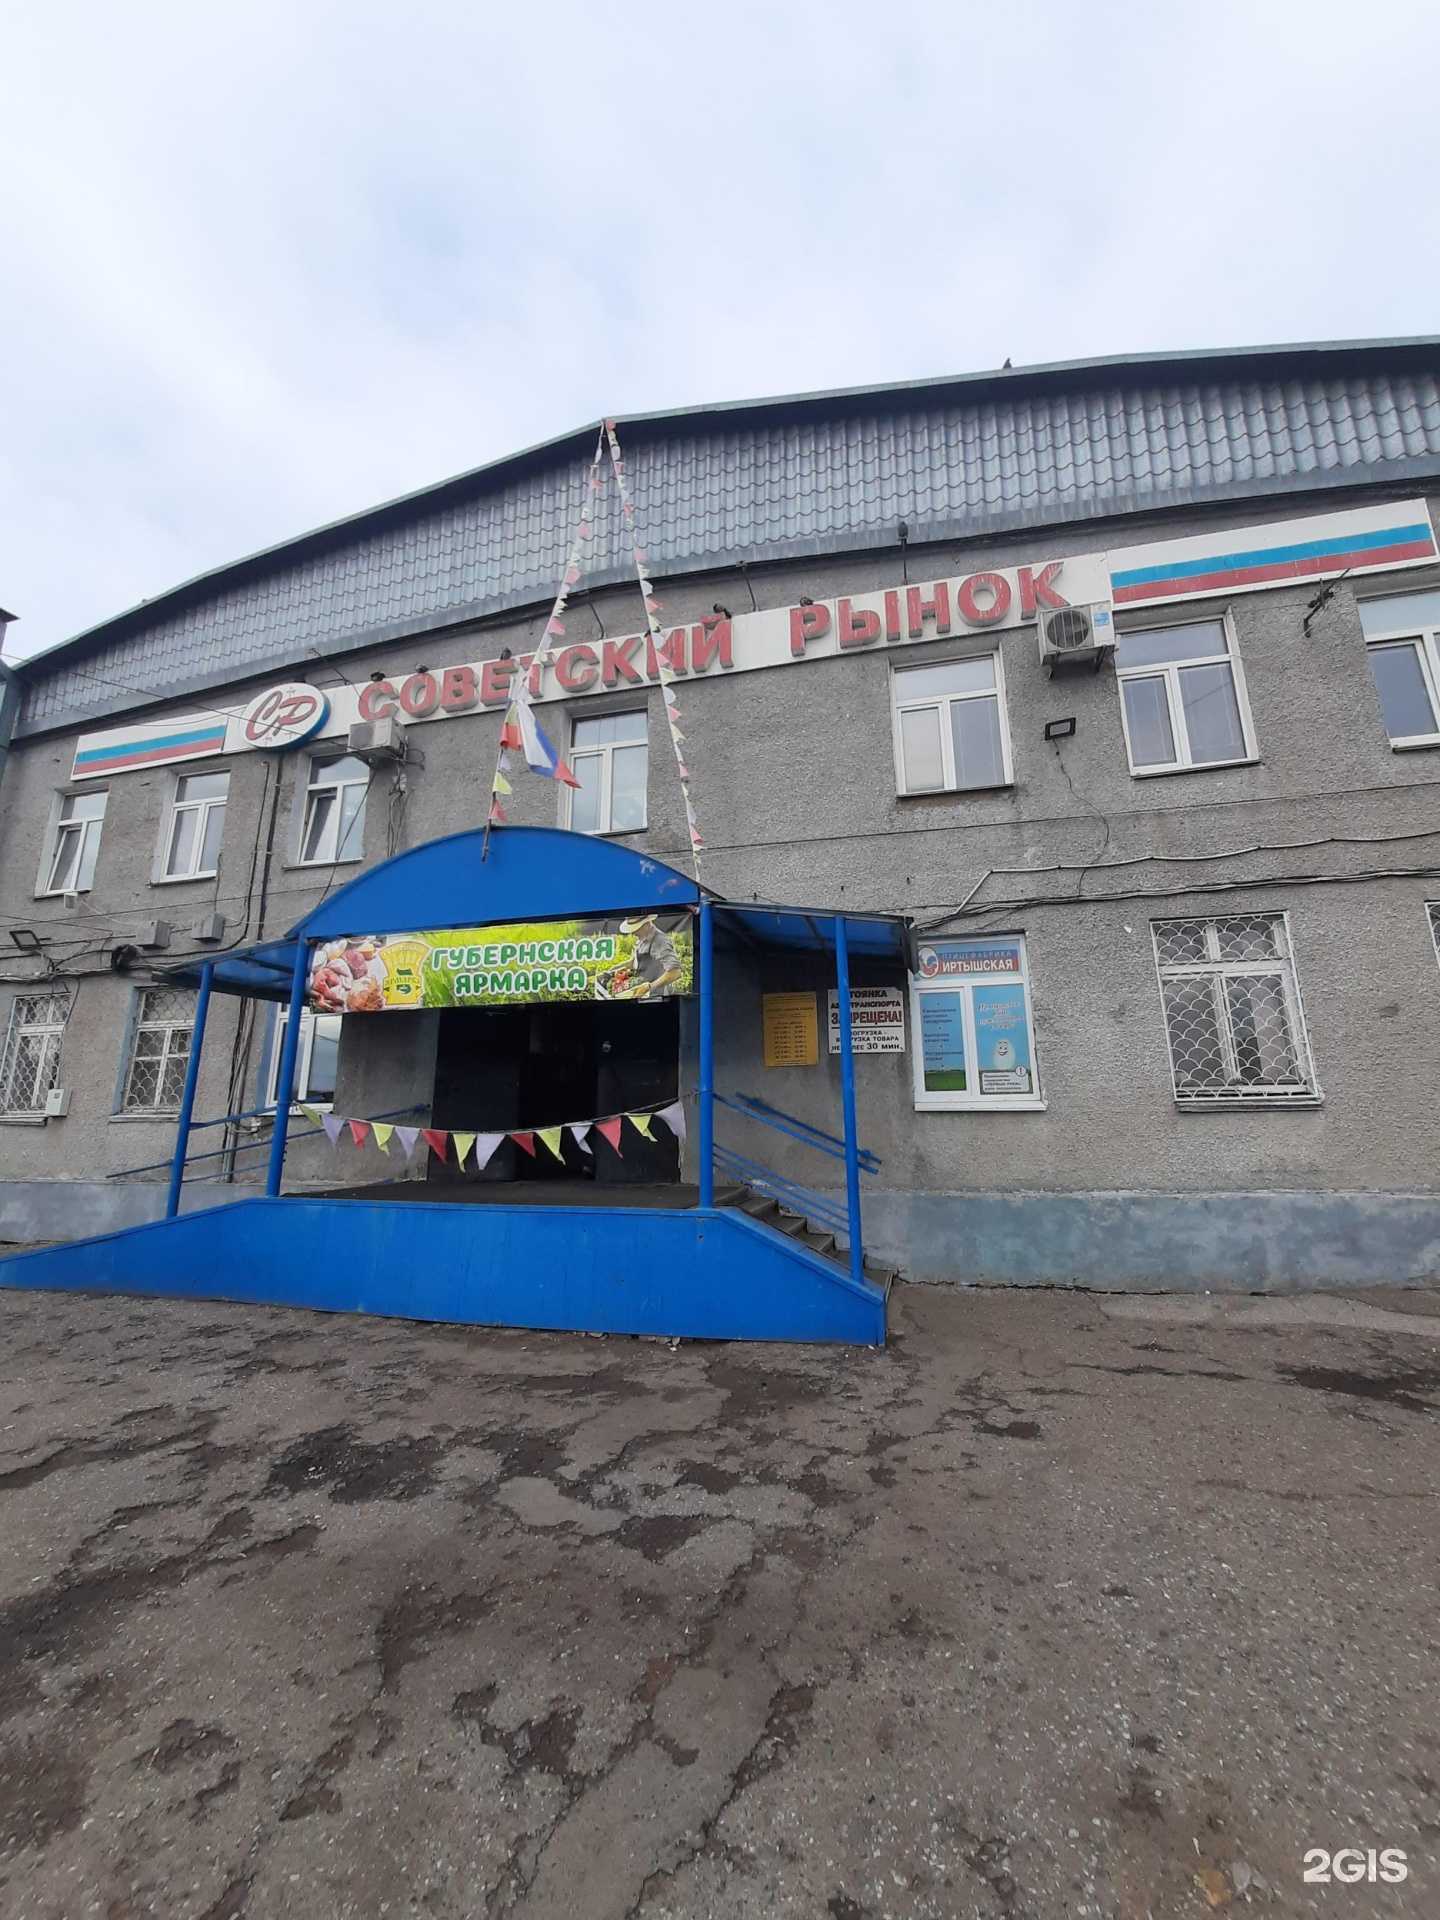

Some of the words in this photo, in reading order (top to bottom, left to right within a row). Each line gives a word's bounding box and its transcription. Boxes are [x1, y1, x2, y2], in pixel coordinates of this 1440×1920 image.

[357, 614, 735, 723] СОВЕТСКИЙ
[788, 561, 1072, 657] РЫНОК
[432, 937, 615, 970] ГУБЕРНСКАЯ
[943, 959, 1013, 972] ИРТЫШСКАЯ
[455, 966, 587, 996] ЯРМАРКА
[848, 990, 888, 998] ТОЯНКА
